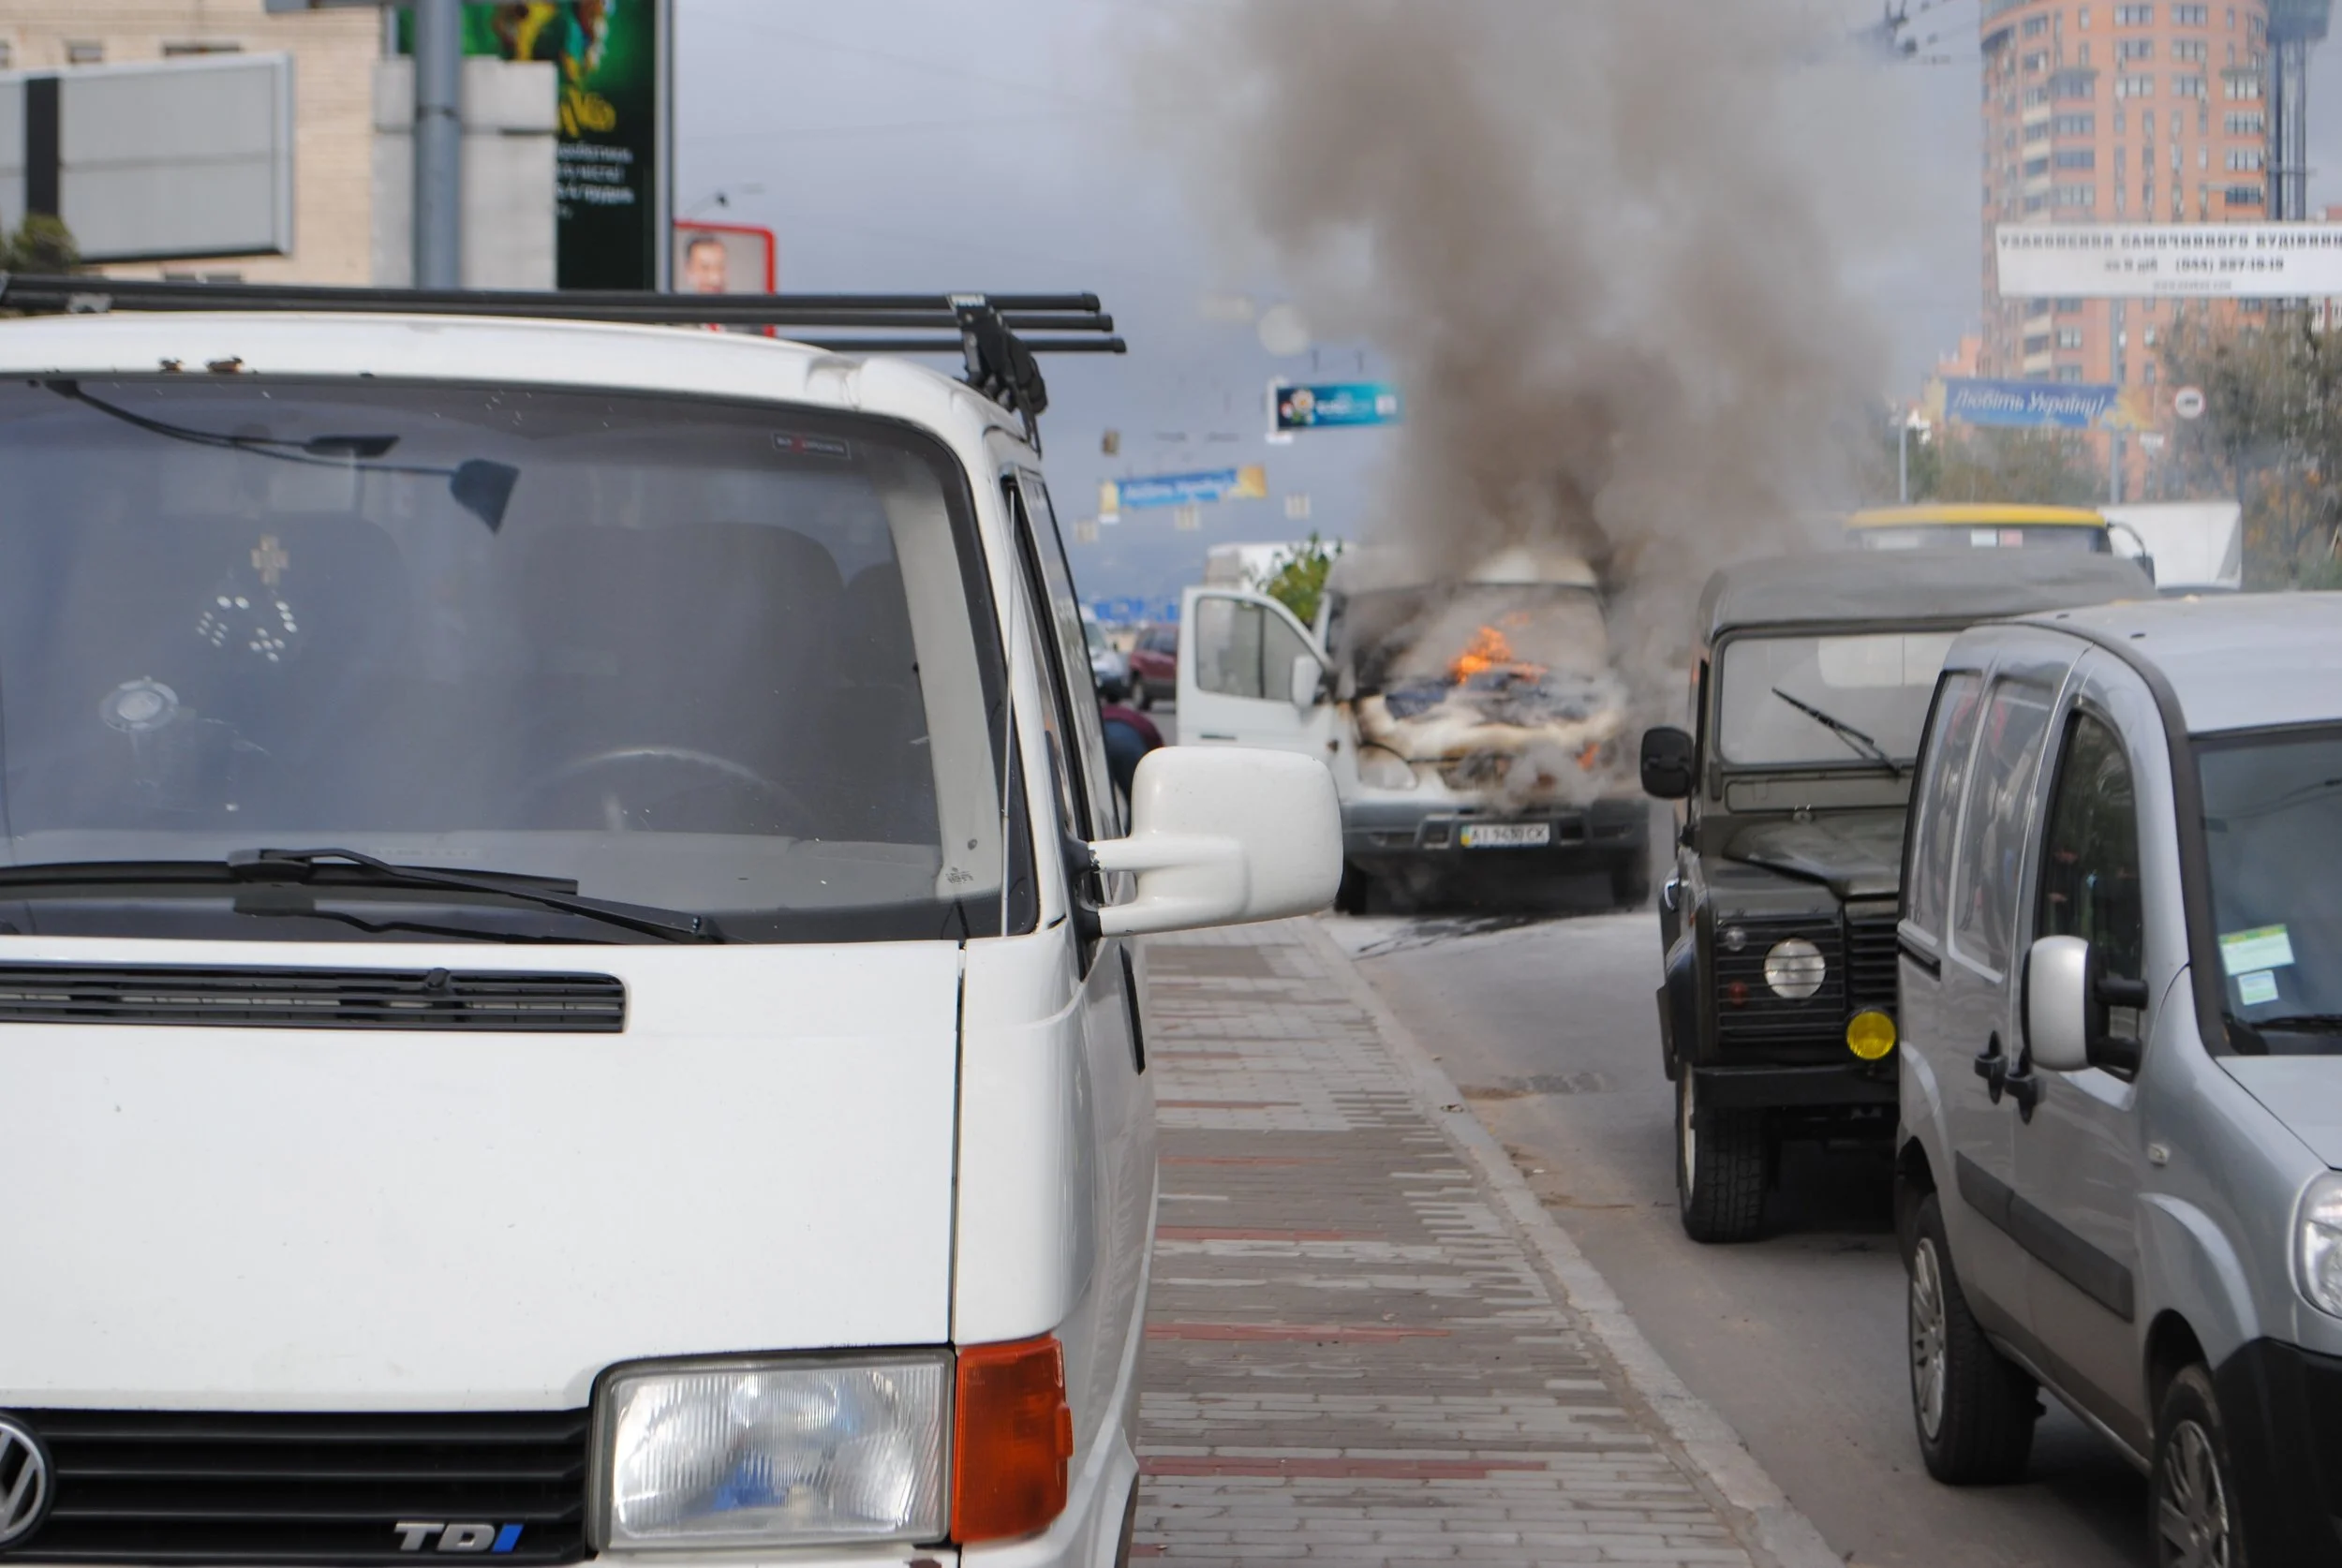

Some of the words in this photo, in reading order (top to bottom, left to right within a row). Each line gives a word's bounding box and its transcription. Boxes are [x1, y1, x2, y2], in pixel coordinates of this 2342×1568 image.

[1953, 385, 2024, 410] Любіть
[2027, 389, 2106, 419] Україну!
[393, 1519, 525, 1554] TDI
